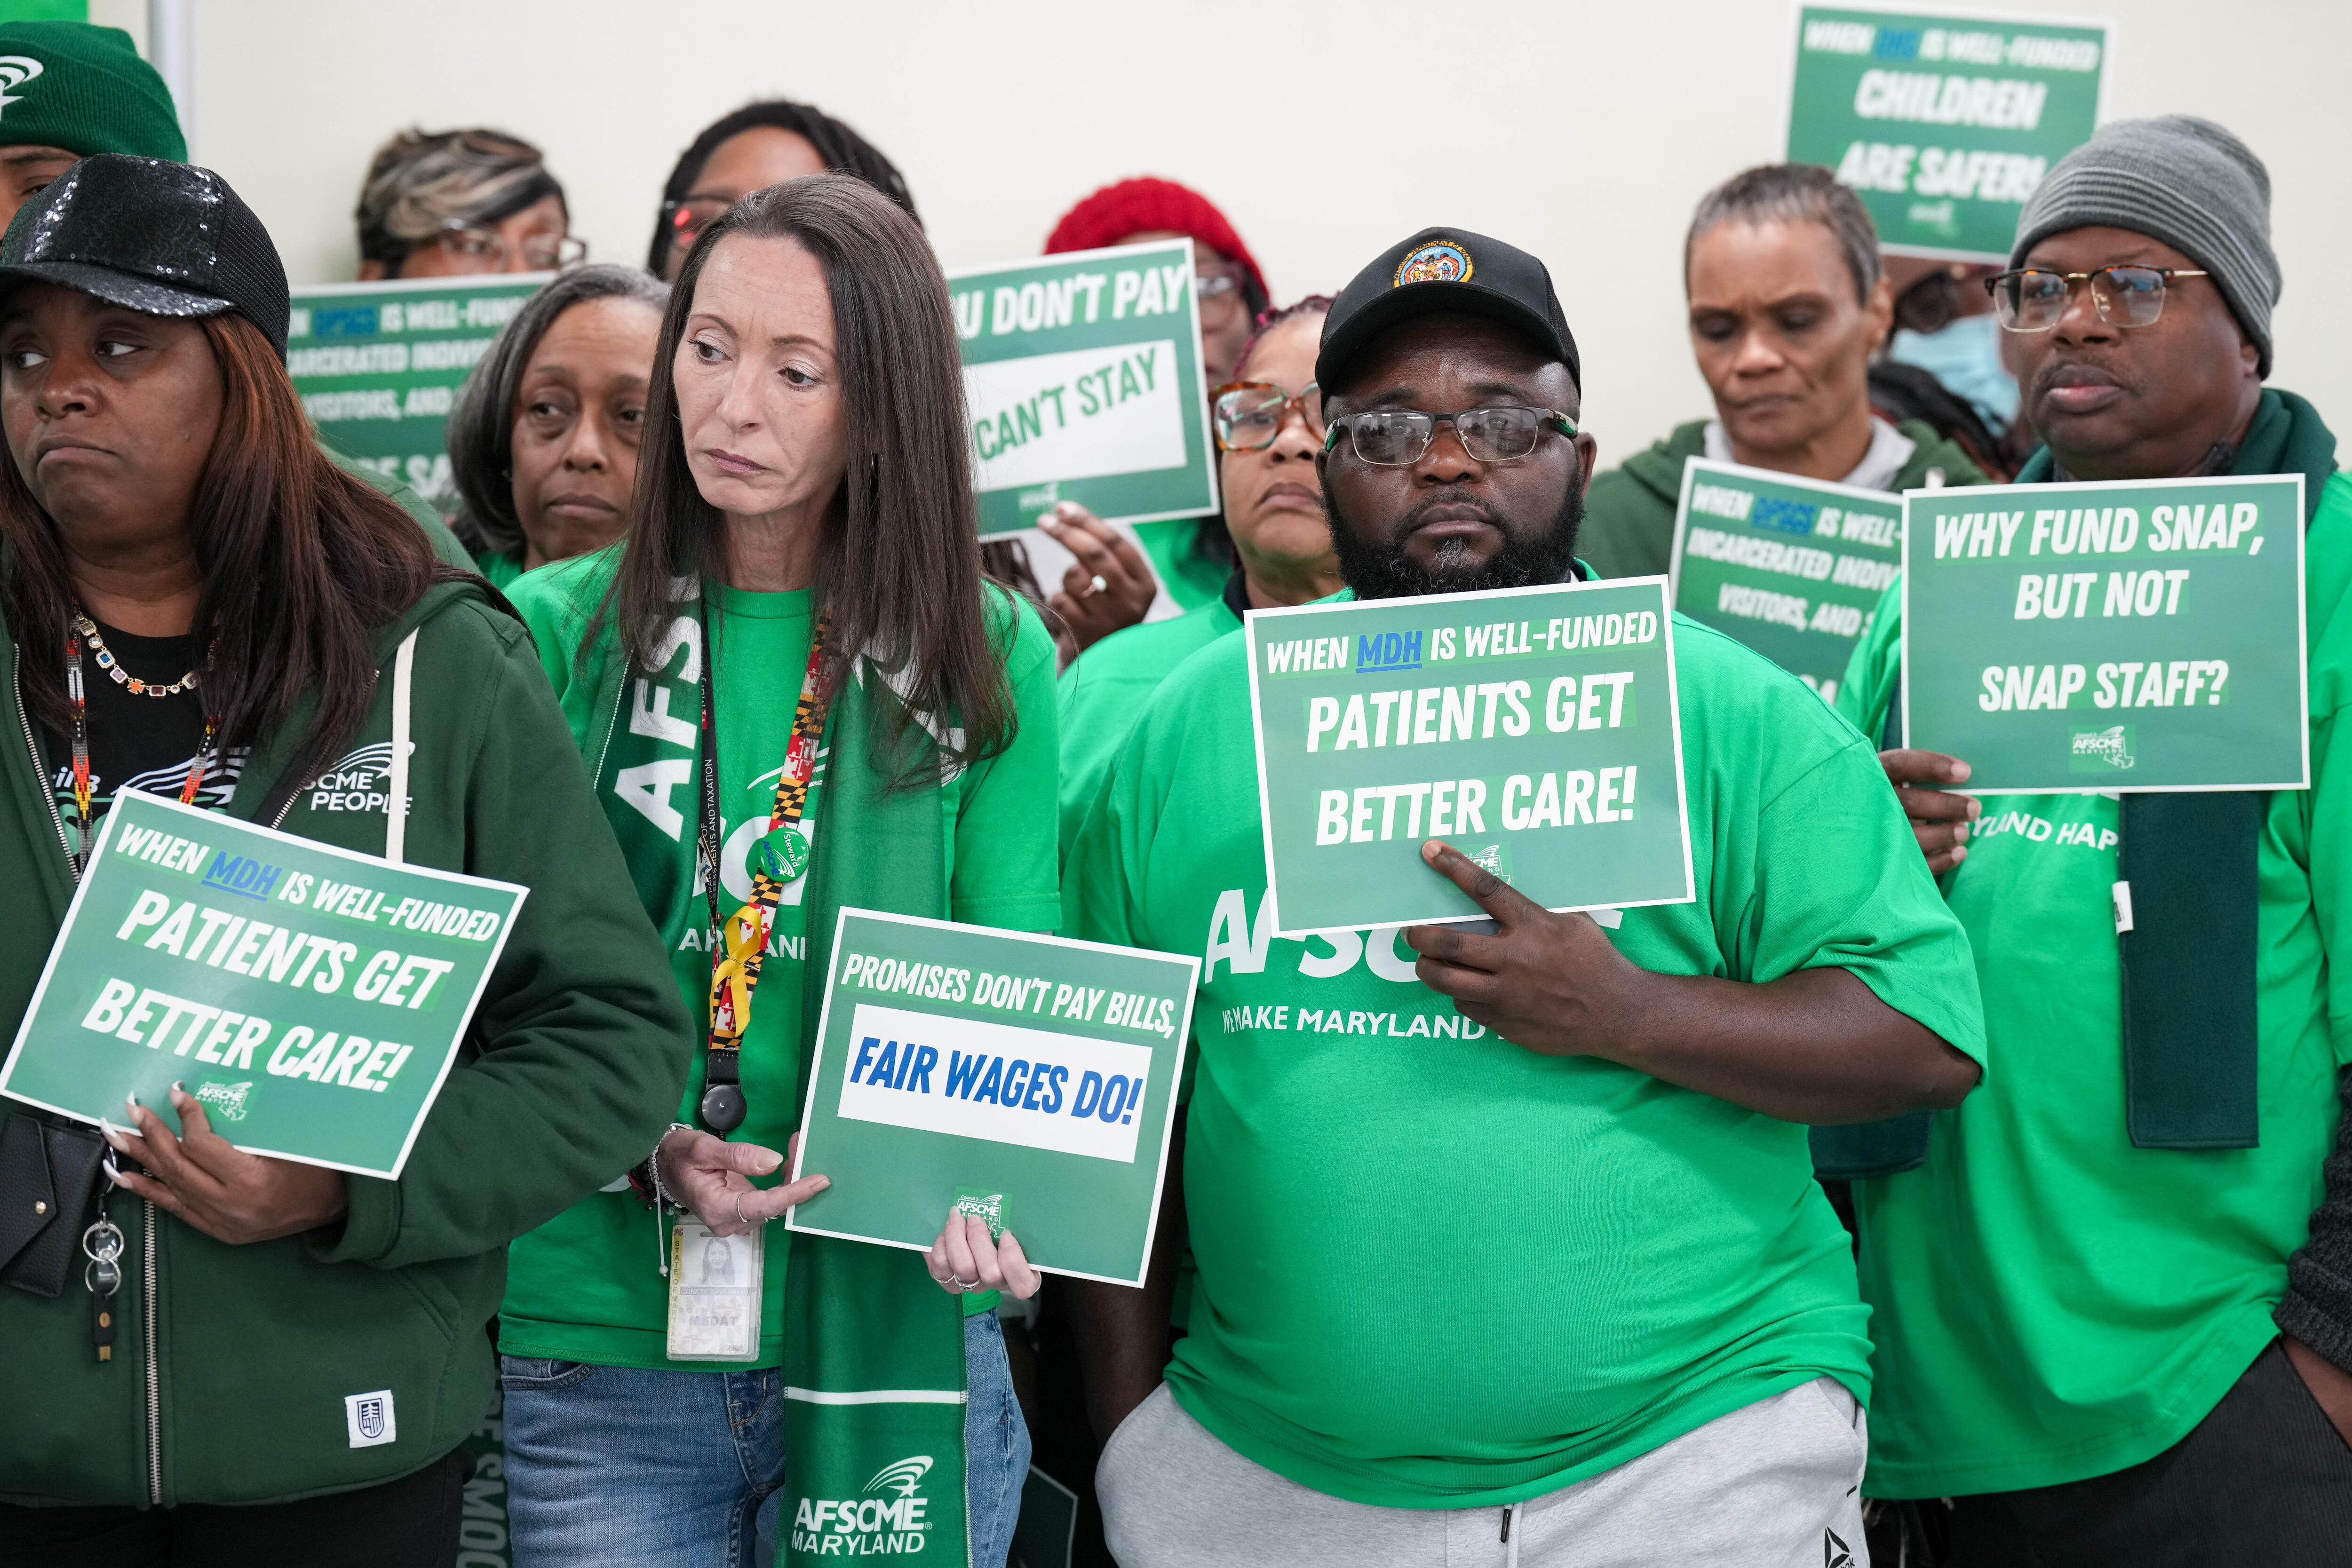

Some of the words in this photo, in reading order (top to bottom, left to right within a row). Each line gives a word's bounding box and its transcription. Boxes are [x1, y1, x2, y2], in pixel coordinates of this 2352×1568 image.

[1804, 19, 1875, 55] WHEN
[1919, 28, 1947, 60] IS
[1854, 69, 2047, 130] CHILDREN
[1836, 141, 1917, 192] ARE
[1422, 248, 1441, 257] MDH
[992, 273, 1107, 335] DON'T
[1112, 264, 1189, 319] PAY
[975, 385, 1066, 461] CAN'T
[1075, 348, 1157, 417] STAY
[1692, 483, 1754, 520] WHEN
[1815, 507, 1842, 538] IS
[1934, 511, 2025, 559] WHY
[2029, 507, 2140, 555] FUND
[2147, 502, 2265, 556] SNAP,
[1686, 527, 1834, 581] INCARCERATED
[1718, 583, 1808, 633] VISITORS,
[1809, 603, 1862, 637] AND
[2014, 573, 2098, 620] BUT
[2103, 570, 2190, 618] NOT
[1267, 637, 1349, 674] WHEN
[1357, 630, 1422, 666] MDH
[1430, 627, 1456, 660] IS
[1464, 611, 1658, 658] WELL-FUNDED
[1306, 680, 1531, 752] PATIENTS
[1545, 672, 1634, 734] GET
[1979, 664, 2086, 712] SNAP
[2093, 659, 2229, 709] STAFF?
[2073, 738, 2122, 749] AFSCME
[705, 759, 715, 808] TAXATION
[1316, 779, 1487, 846] BETTER
[1501, 765, 1637, 831] CARE!
[700, 823, 708, 836] OF
[783, 834, 800, 868] Steward
[114, 823, 209, 875] WHEN
[205, 852, 281, 892] MDH
[278, 871, 314, 904] IS
[312, 879, 501, 942] WELL-FUNDED
[762, 840, 779, 877] AFSCME
[1472, 857, 1498, 868] CME
[115, 889, 358, 995] PATIENTS
[353, 949, 455, 1009] GET
[841, 953, 971, 1003] PROMISES
[973, 972, 1052, 1014] DON'T
[1051, 984, 1106, 1022] PAY
[1104, 991, 1176, 1038] BILLS,
[80, 977, 272, 1070] BETTER
[266, 1025, 414, 1093] CARE!
[1223, 1010, 1234, 1034] WE
[1233, 1005, 1289, 1030] MAKE
[1296, 1008, 1486, 1040] MARYLAND
[196, 1087, 245, 1101] AFSCME
[850, 1037, 938, 1094] FAIR
[945, 1050, 1068, 1115] WAGES
[1071, 1069, 1143, 1125] DO!
[958, 1201, 999, 1216] AFSCME
[673, 1279, 679, 1293] OF
[792, 1529, 925, 1556] MARYLAND
